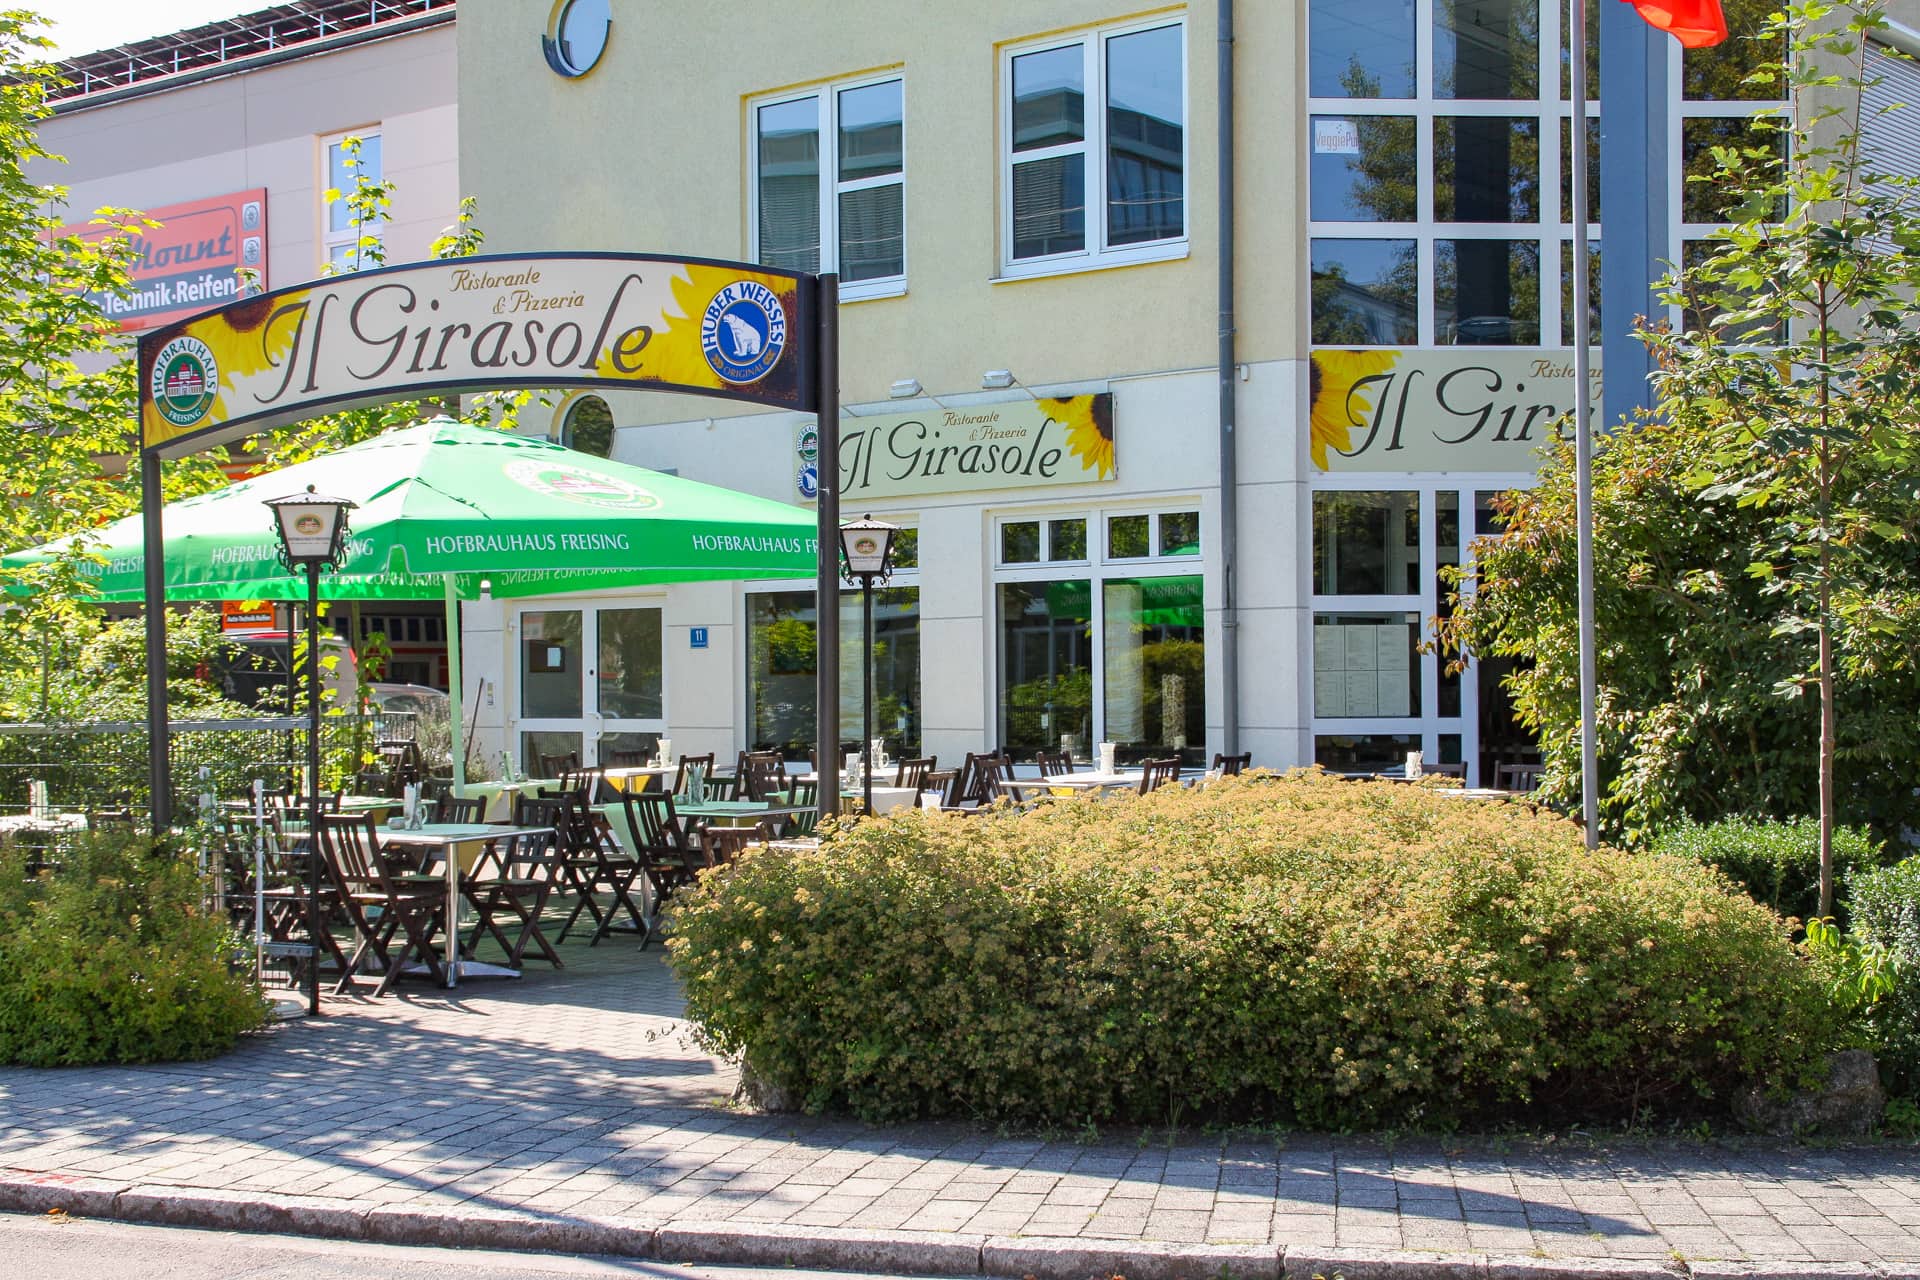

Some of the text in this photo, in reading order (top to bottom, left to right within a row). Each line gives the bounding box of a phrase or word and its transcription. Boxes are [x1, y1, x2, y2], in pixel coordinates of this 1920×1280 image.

[449, 265, 541, 292] Ristorante
[509, 289, 585, 313] Pizzeria
[703, 282, 785, 349] HUBER WEISSES
[253, 273, 654, 404] Il Girasole
[153, 338, 217, 394] HOFBRAUHAUS
[723, 364, 765, 378] ORIGINAL
[168, 408, 202, 422] FREISING
[943, 411, 1000, 427] Ristorante
[980, 425, 1027, 441] Pizzeria
[886, 416, 1062, 480] Girasole
[426, 533, 630, 554] HOFBRAUHAUS FREISING
[692, 534, 801, 553] HOFBRAUHAUS
[695, 629, 703, 641] 11
